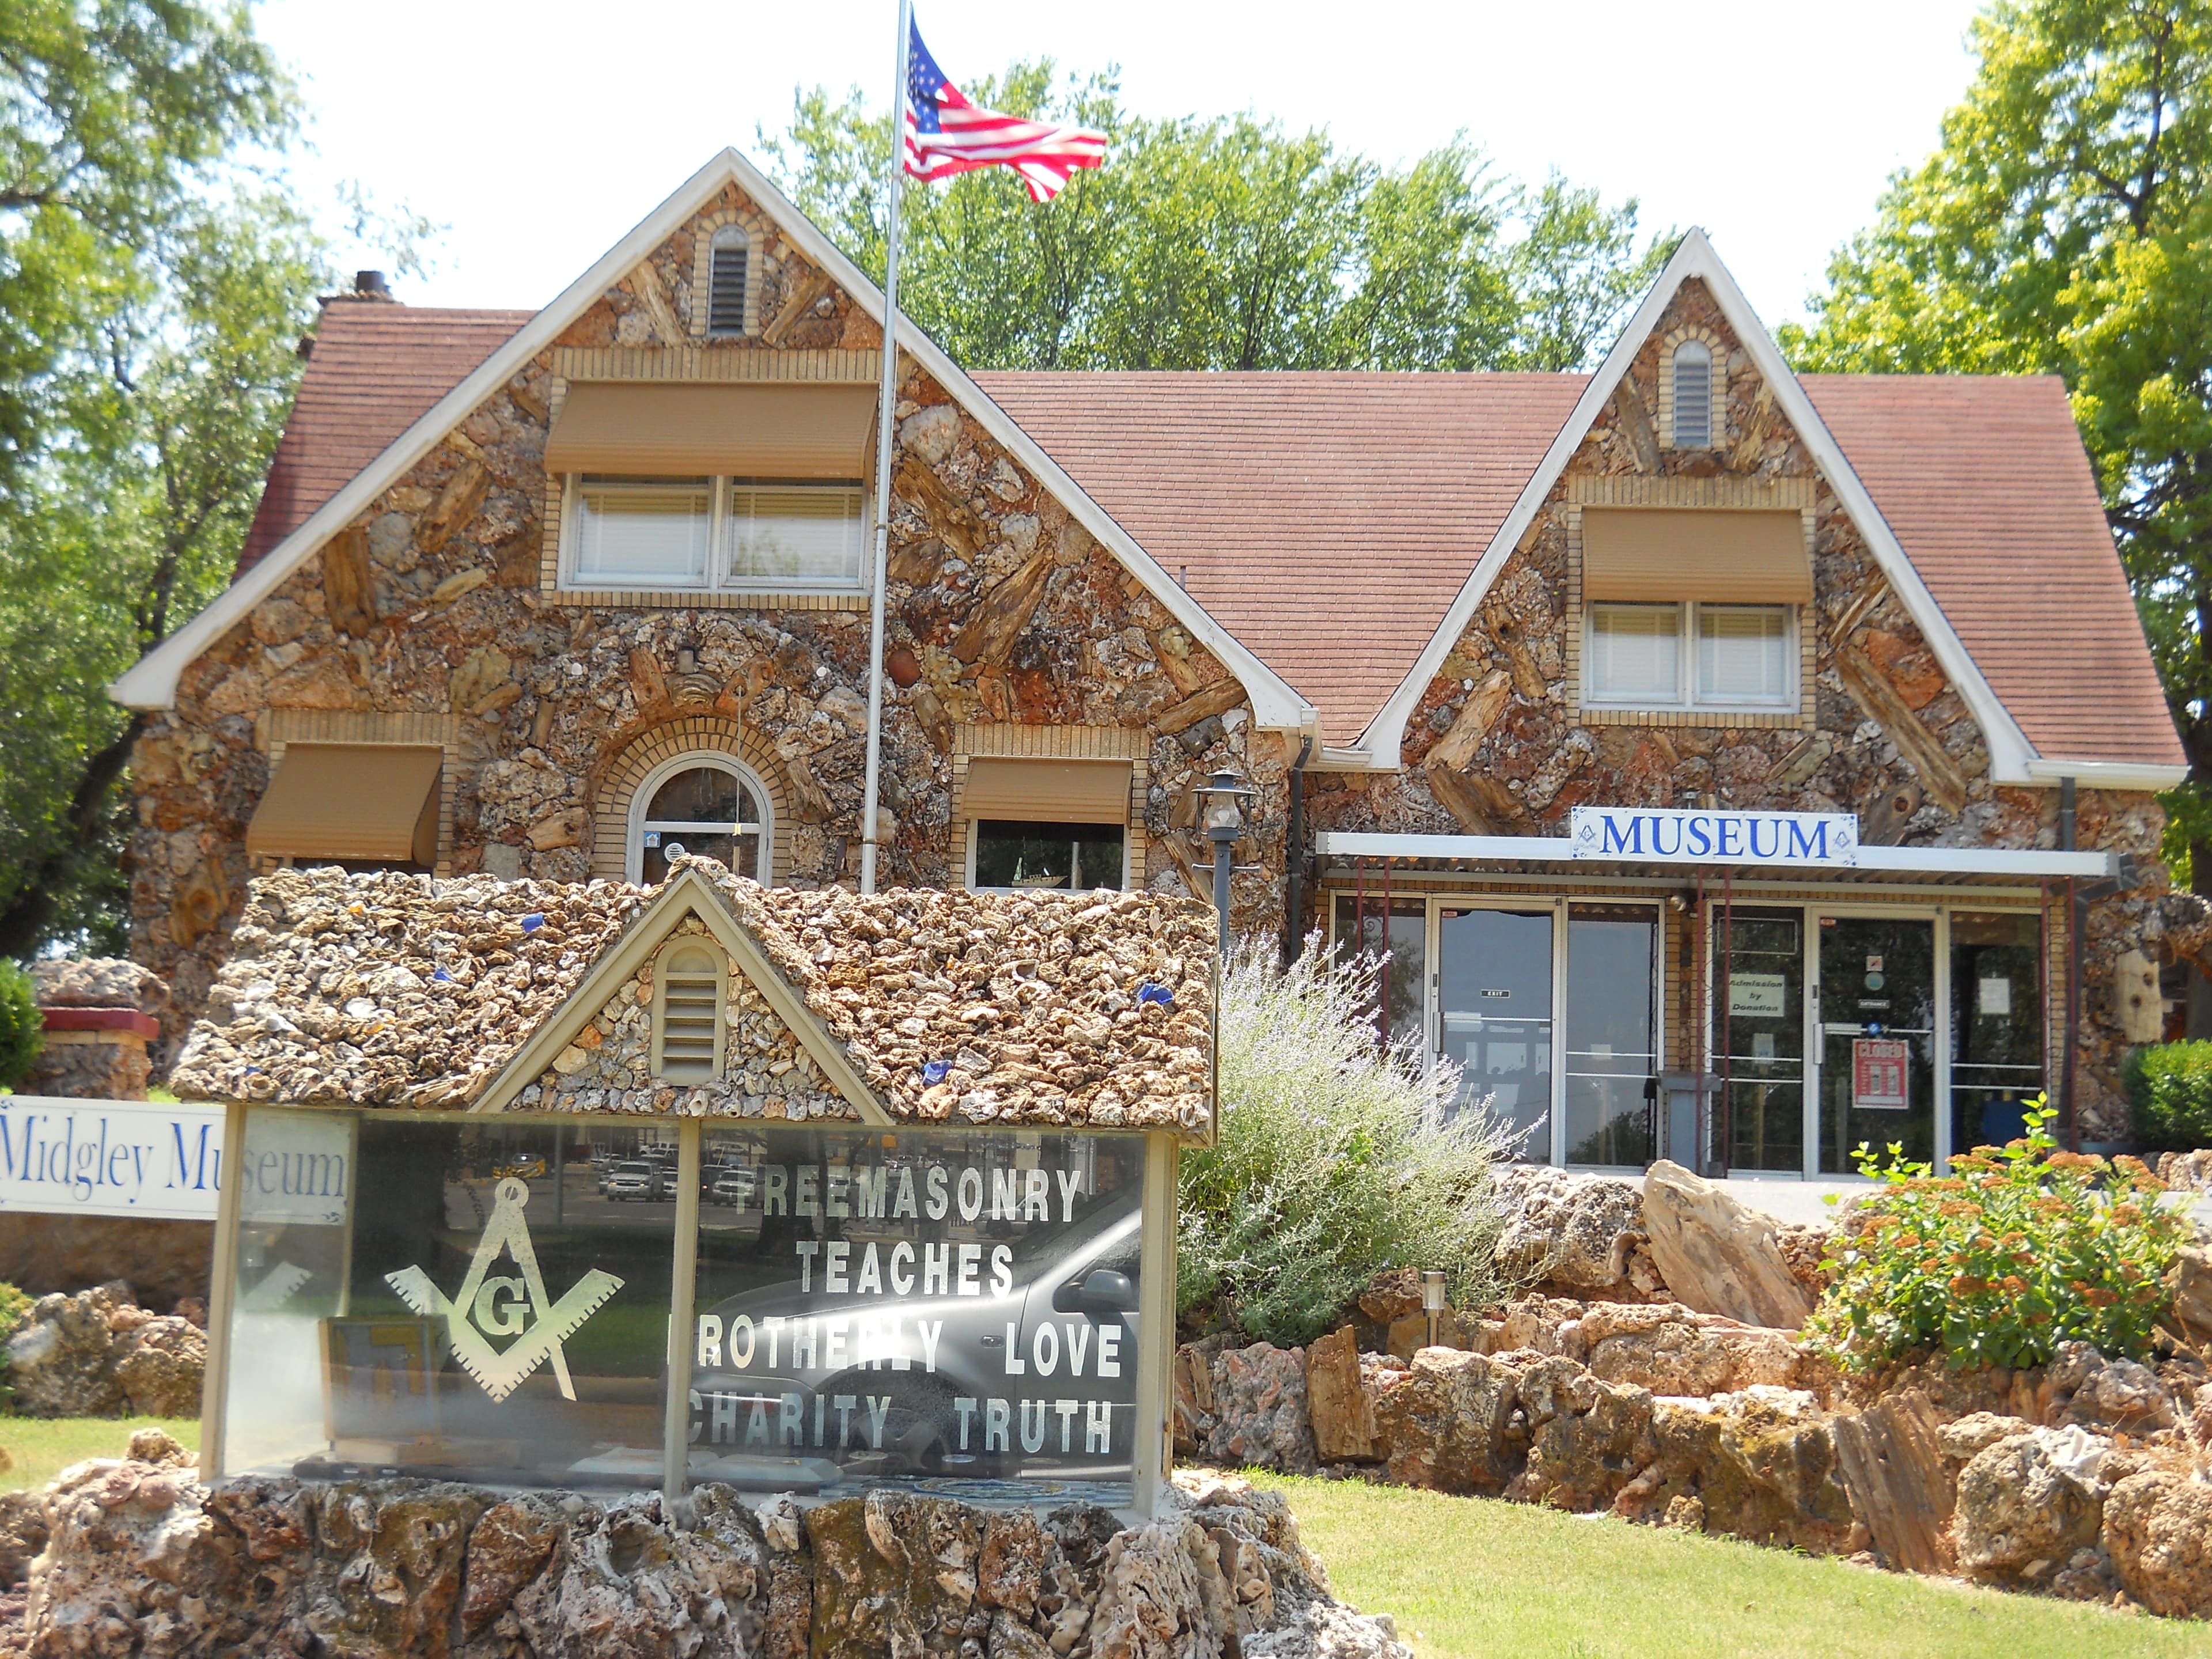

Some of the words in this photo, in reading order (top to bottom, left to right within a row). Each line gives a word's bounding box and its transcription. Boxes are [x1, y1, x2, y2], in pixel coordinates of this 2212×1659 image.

[1599, 815, 1831, 858] MUSEUM
[1749, 993, 1762, 1001] by
[1858, 1044, 1903, 1058] CLOSED
[0, 1113, 153, 1204] Midgley
[796, 1241, 1012, 1298] TEACHES
[475, 1276, 530, 1335] G
[667, 1313, 944, 1373] ROTHERLY
[1005, 1321, 1121, 1377] LOVE
[955, 1397, 1112, 1453] TRUTH
